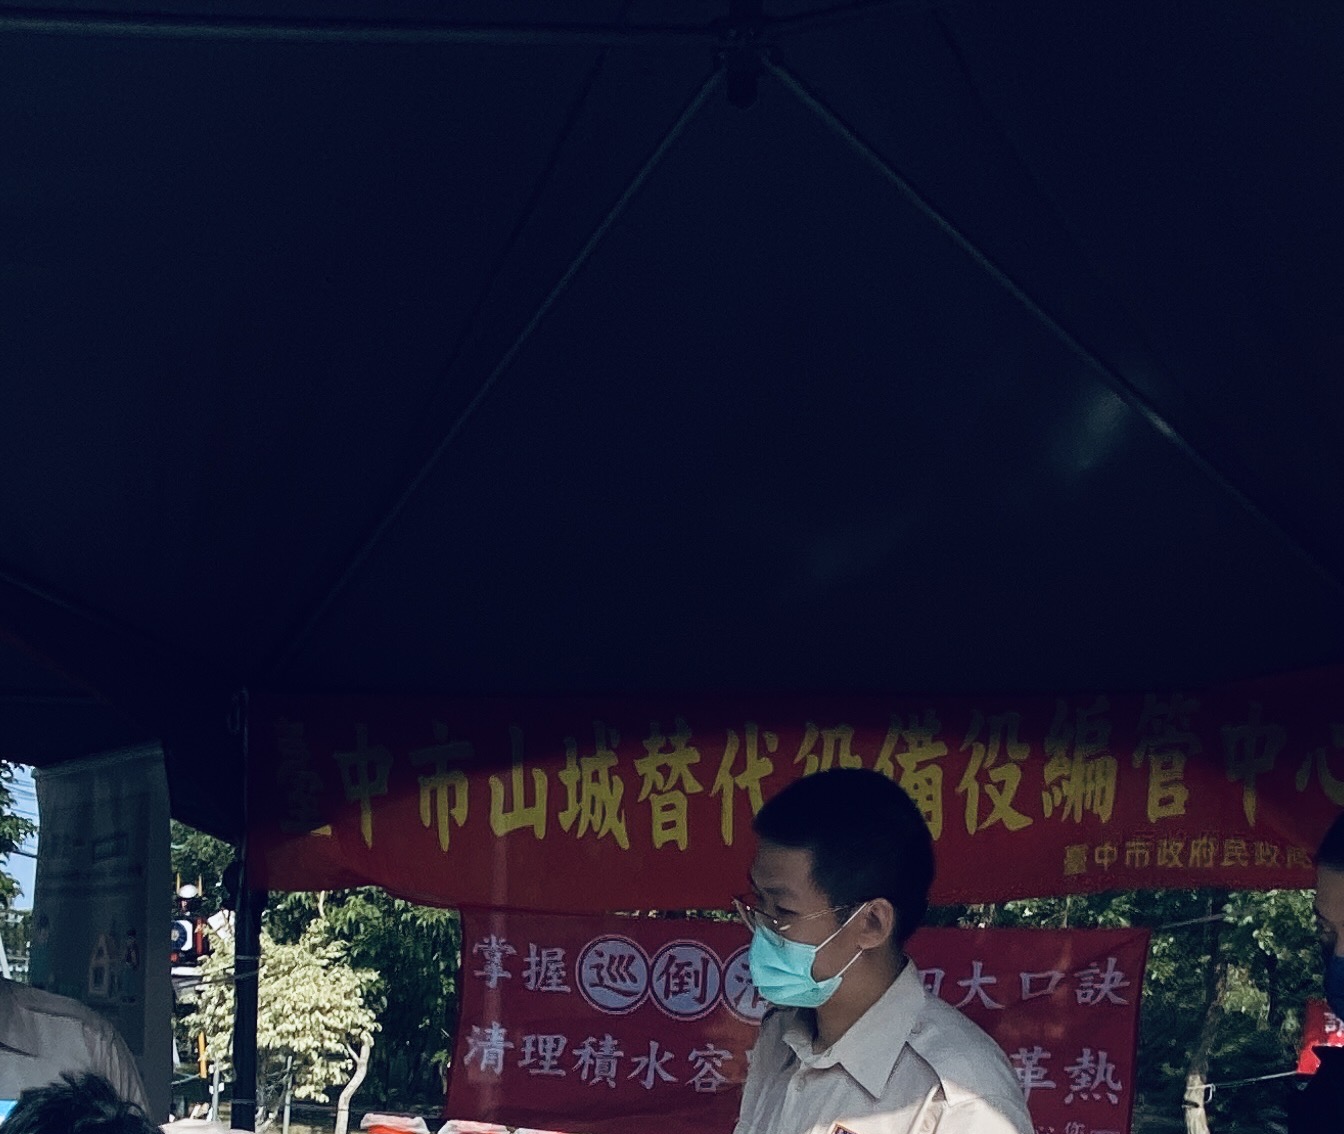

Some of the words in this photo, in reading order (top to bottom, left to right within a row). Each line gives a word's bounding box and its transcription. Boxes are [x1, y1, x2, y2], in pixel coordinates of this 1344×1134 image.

[463, 1020, 754, 1095] 清理積水容
